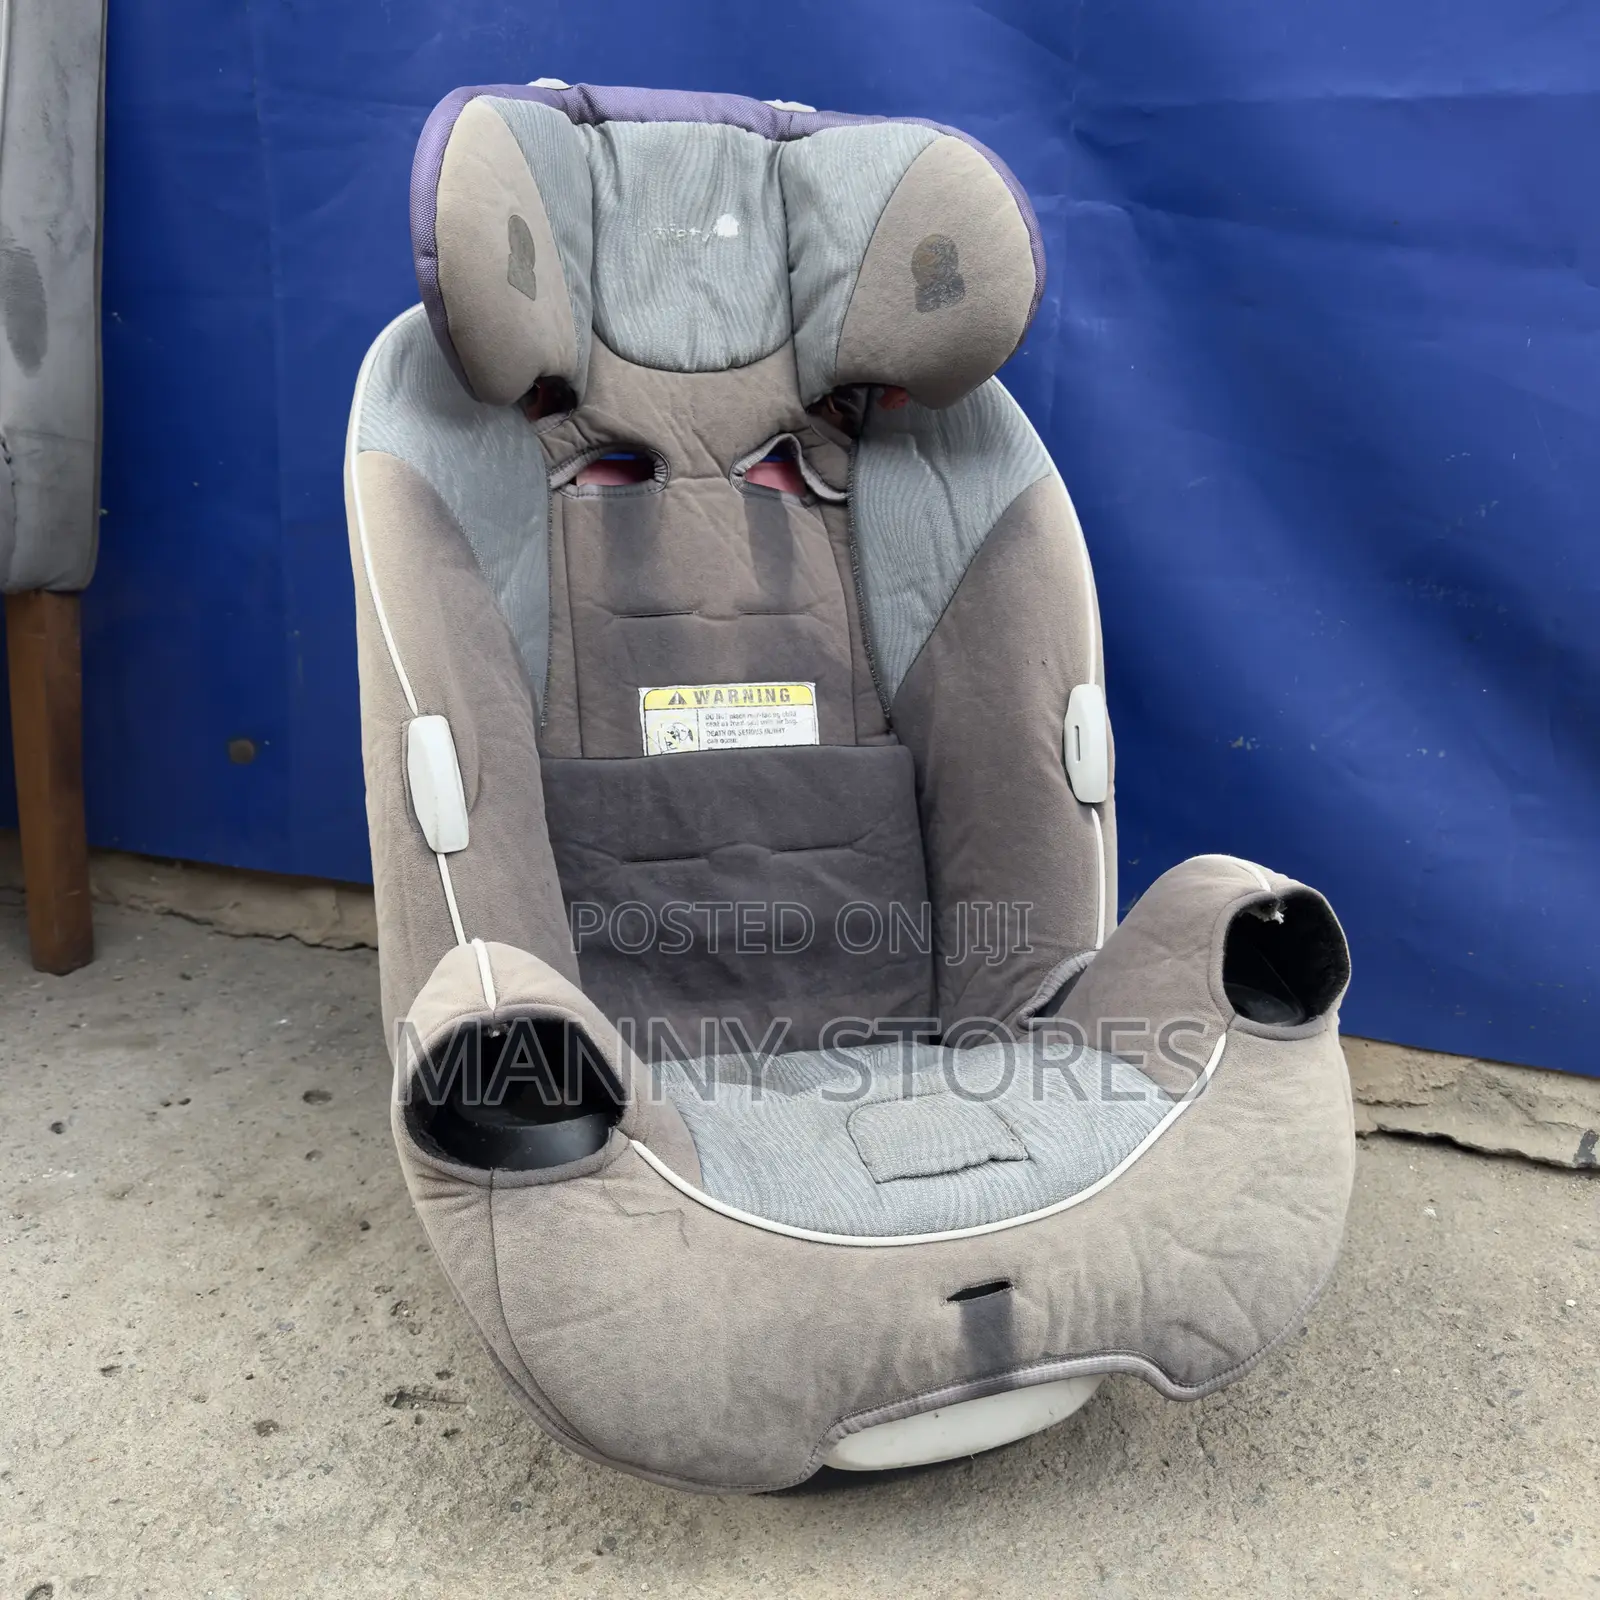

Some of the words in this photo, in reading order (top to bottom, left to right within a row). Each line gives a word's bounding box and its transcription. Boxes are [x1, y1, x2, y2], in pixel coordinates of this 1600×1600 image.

[693, 688, 791, 705] WARNING
[706, 729, 726, 737] DEATH
[738, 728, 763, 736] SERIOUS
